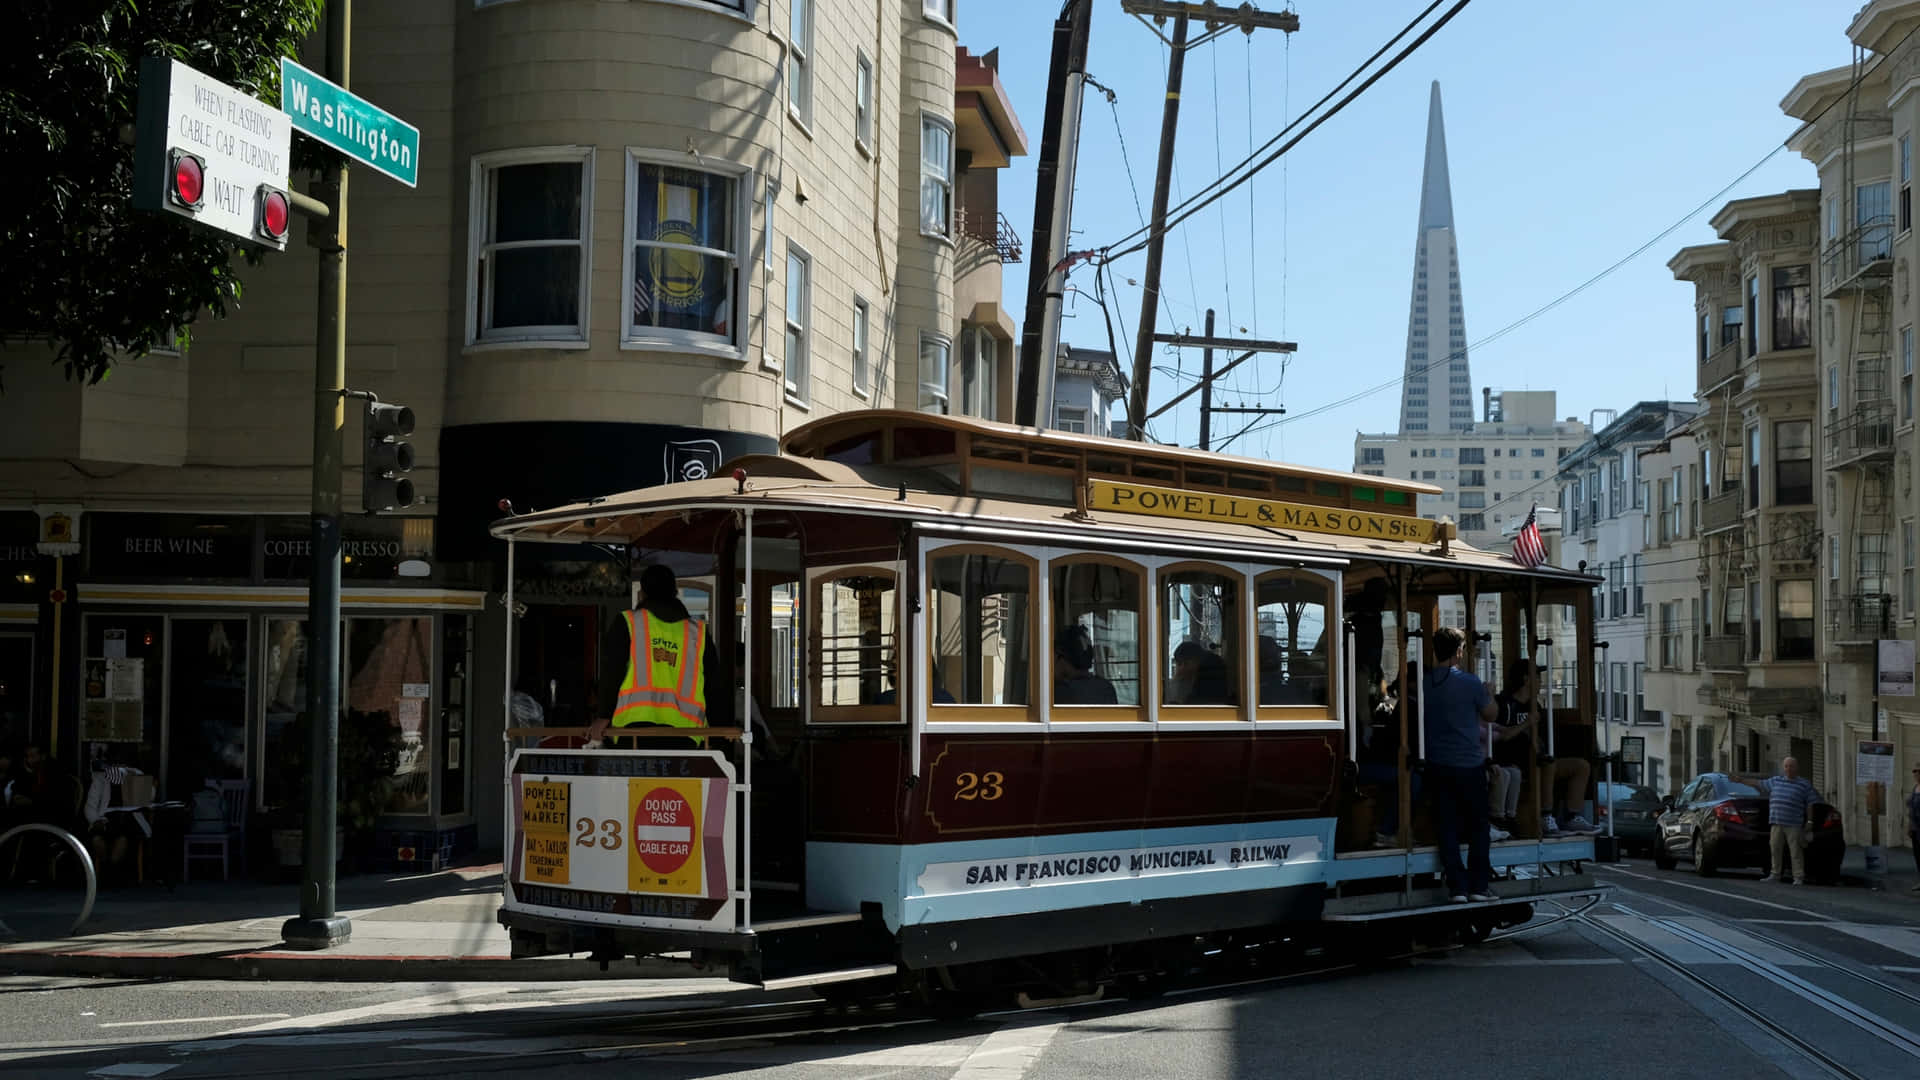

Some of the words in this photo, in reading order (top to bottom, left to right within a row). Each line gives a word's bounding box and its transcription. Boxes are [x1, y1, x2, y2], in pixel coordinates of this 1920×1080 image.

[194, 84, 224, 117] WHEN
[227, 100, 272, 140] FLASHING
[291, 77, 410, 169] Washington
[180, 114, 211, 147] CABLE
[215, 130, 235, 156] CAR
[239, 139, 280, 176] TURNING
[214, 177, 244, 216] WAIT
[1112, 487, 1249, 518] POWELL
[1256, 503, 1277, 523] &
[1283, 507, 1385, 534] MASON
[1388, 519, 1422, 538] Sts.
[124, 537, 164, 554] BEER
[168, 537, 216, 556] WINE
[525, 787, 566, 801] POWELL
[953, 771, 1004, 801] 23
[524, 810, 566, 825] MARKET
[535, 800, 556, 810] AND
[645, 799, 660, 811] DO
[661, 799, 683, 812] NOT
[651, 812, 677, 824] PASS
[575, 816, 623, 851] 23
[639, 842, 668, 855] CABLE
[669, 844, 689, 856] CAR
[966, 863, 1008, 885] SAN
[1015, 855, 1121, 881] FRANCISCO
[1130, 848, 1216, 871] MUNICIPAL
[1229, 844, 1291, 864] RAILWAY
